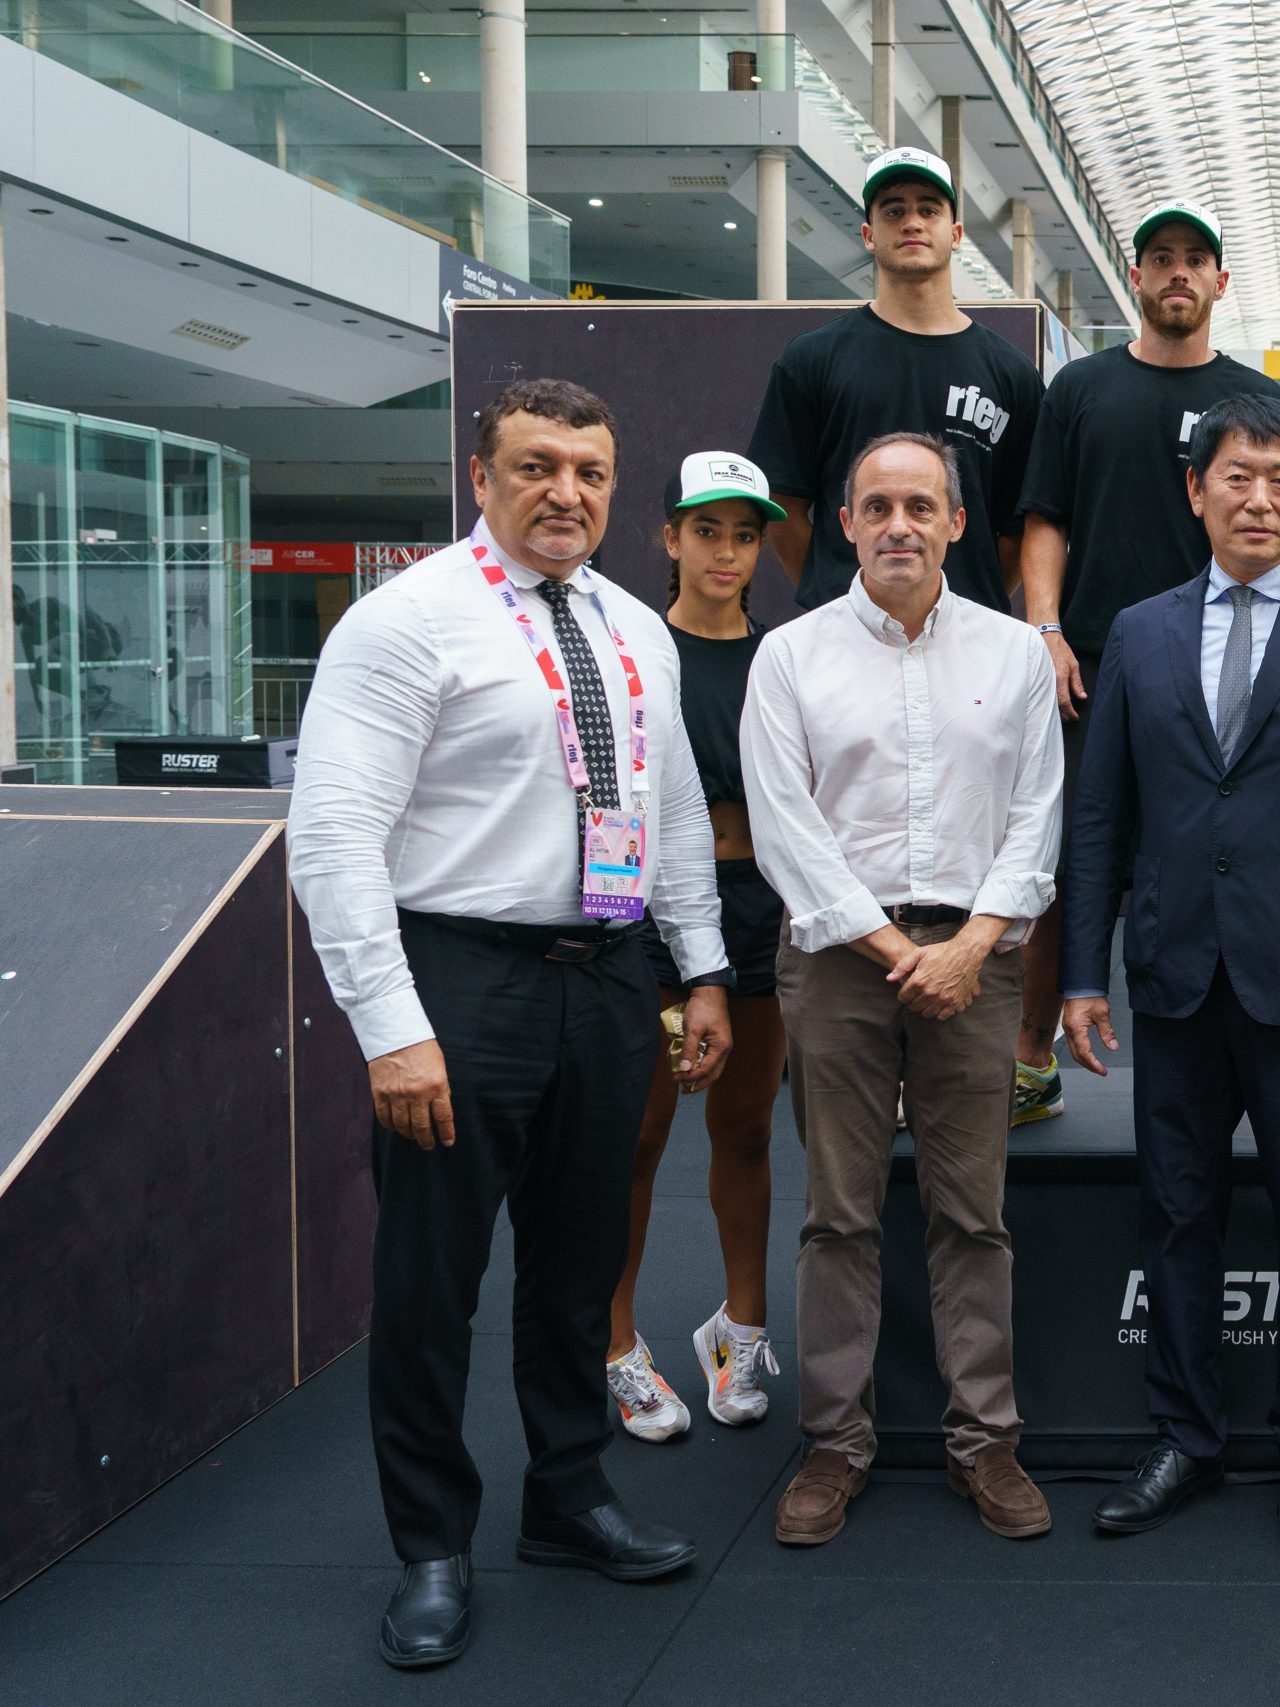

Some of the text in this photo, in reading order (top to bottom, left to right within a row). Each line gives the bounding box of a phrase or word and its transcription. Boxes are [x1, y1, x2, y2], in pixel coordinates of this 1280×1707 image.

[478, 272, 497, 290] Centro
[946, 385, 1010, 445] rfeg
[501, 591, 516, 608] rfeg
[162, 753, 219, 768] RUSTER
